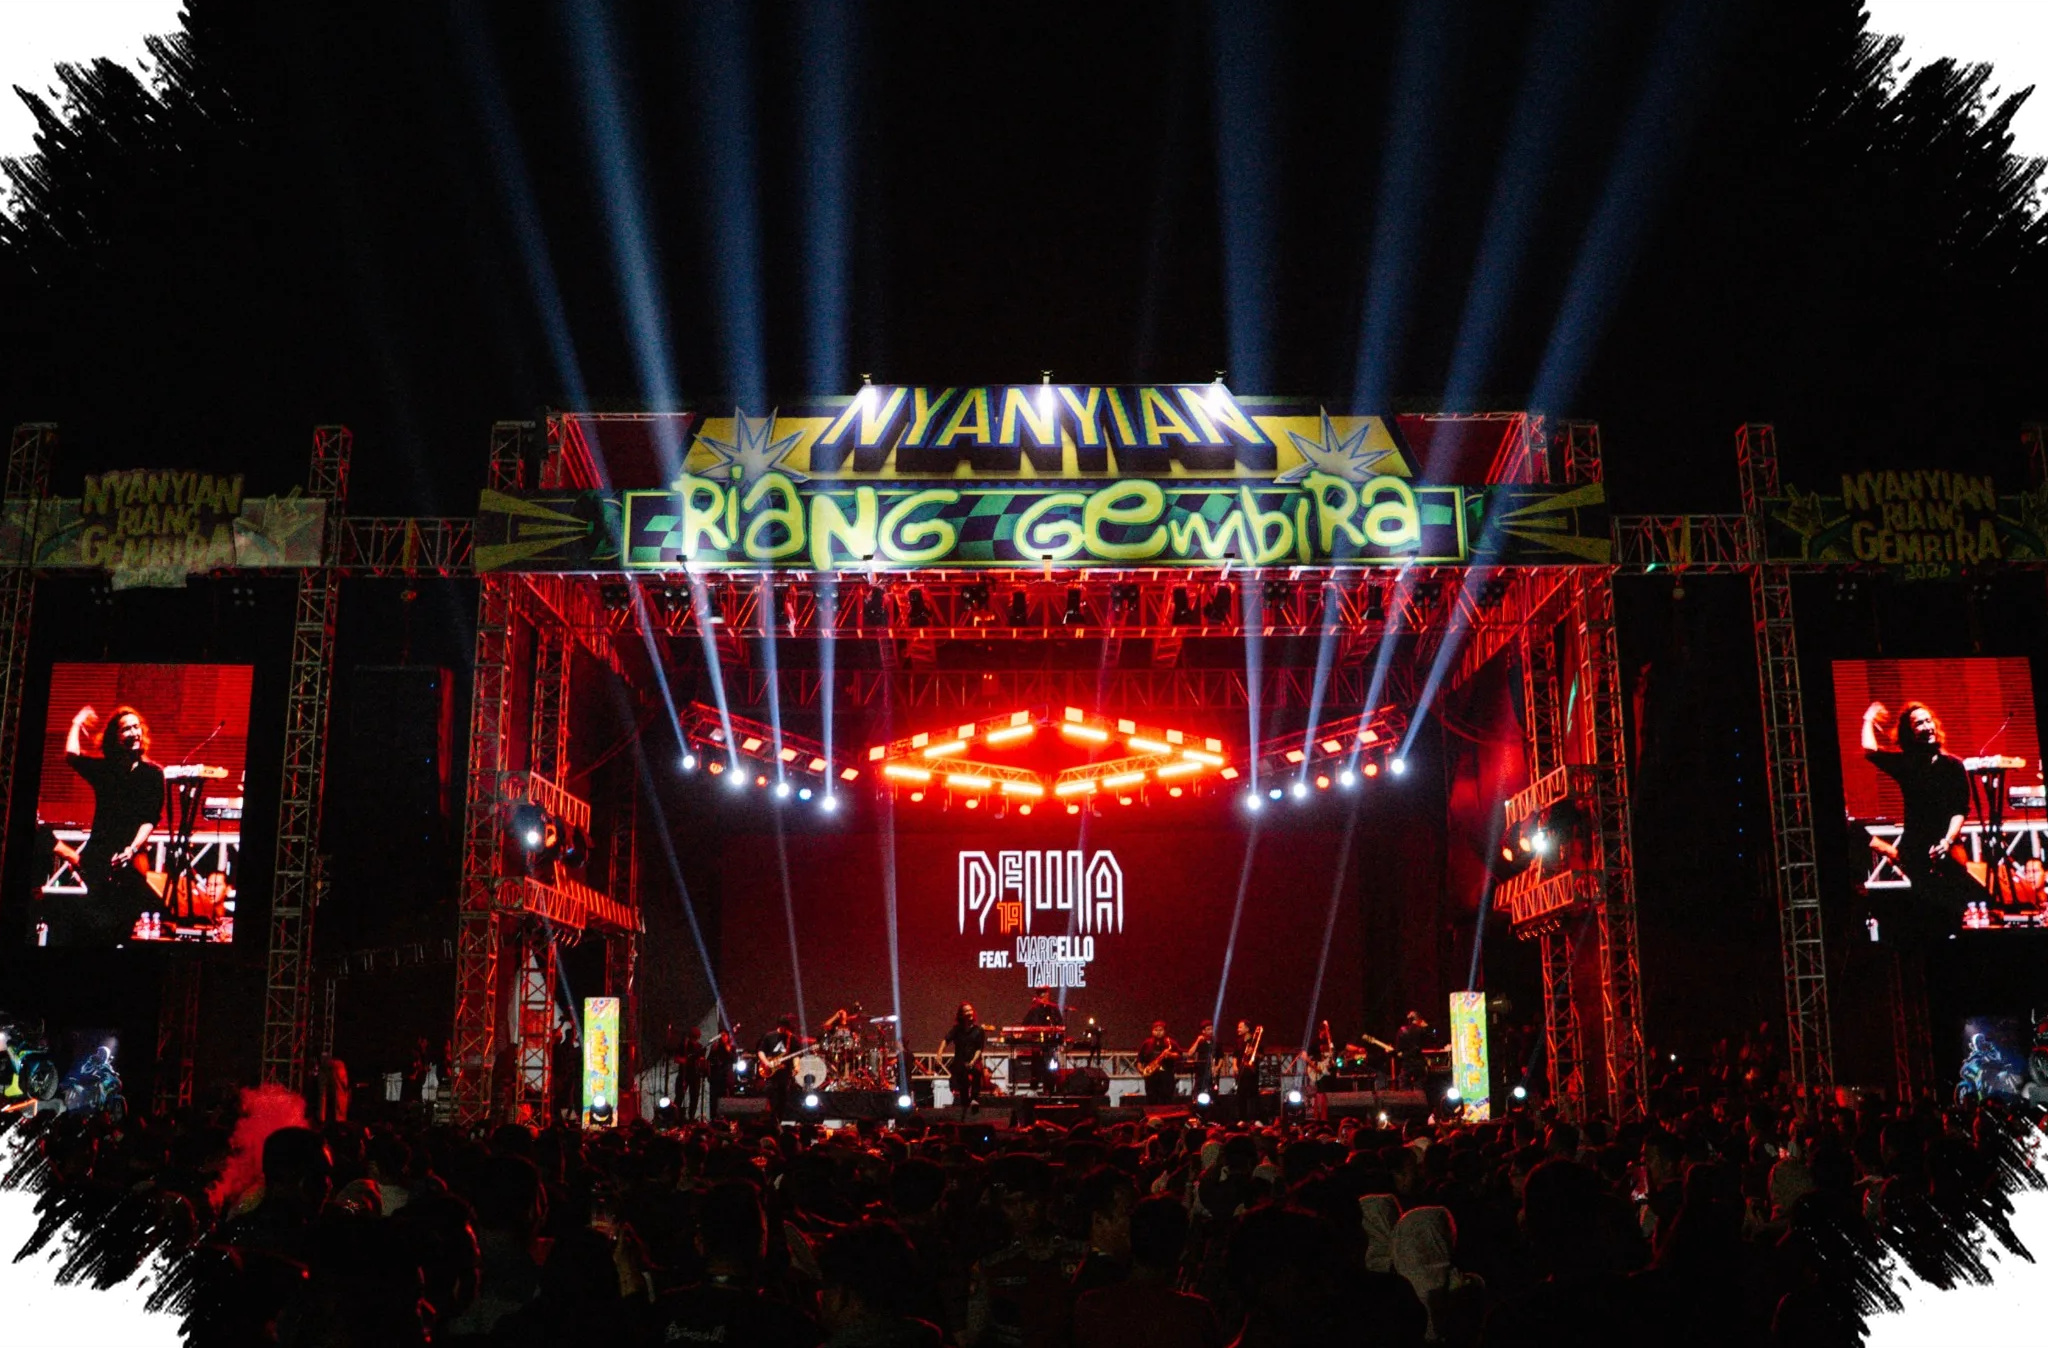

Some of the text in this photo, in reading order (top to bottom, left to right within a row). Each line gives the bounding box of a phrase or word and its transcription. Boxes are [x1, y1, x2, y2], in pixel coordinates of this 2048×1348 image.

[814, 385, 1272, 449] NYANYIAN
[82, 468, 245, 515] NYANYIAN
[1840, 467, 1998, 512] NYANYIAN
[670, 464, 1422, 571] RiaNG GembiRa
[1882, 500, 1966, 534] RIANG
[958, 850, 1124, 935] DEWA
[996, 902, 1023, 934] 19
[979, 936, 1094, 969] FEAT. MARCELLO
[1025, 961, 1087, 988] TAHITOE
